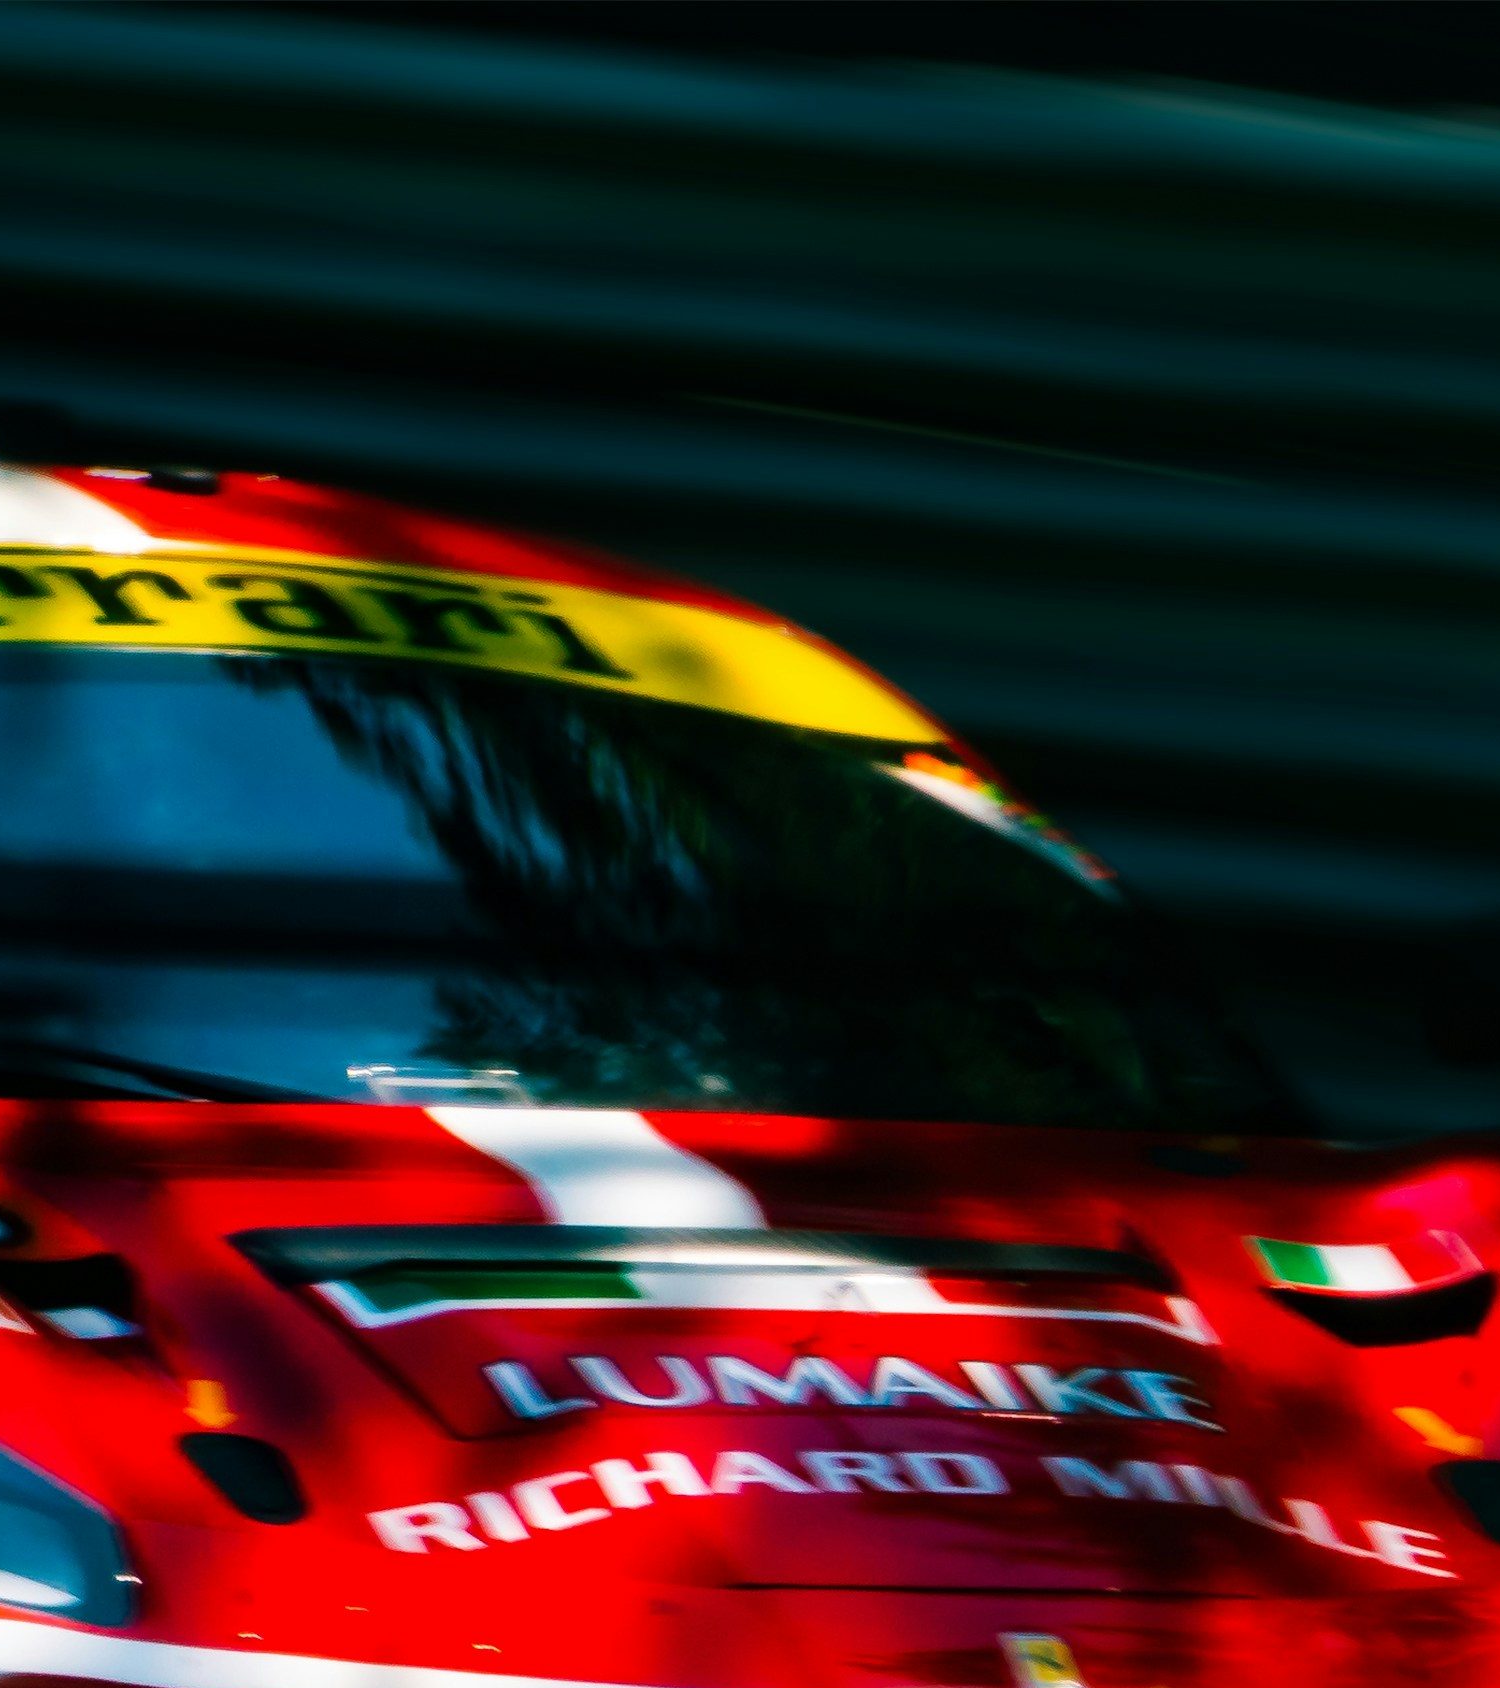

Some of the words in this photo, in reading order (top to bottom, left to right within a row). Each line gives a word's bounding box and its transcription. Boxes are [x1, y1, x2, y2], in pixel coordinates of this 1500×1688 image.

[482, 1355, 1227, 1433] LUMAIKE
[366, 1450, 1010, 1554] RICHARD
[1040, 1456, 1461, 1580] MILLE
